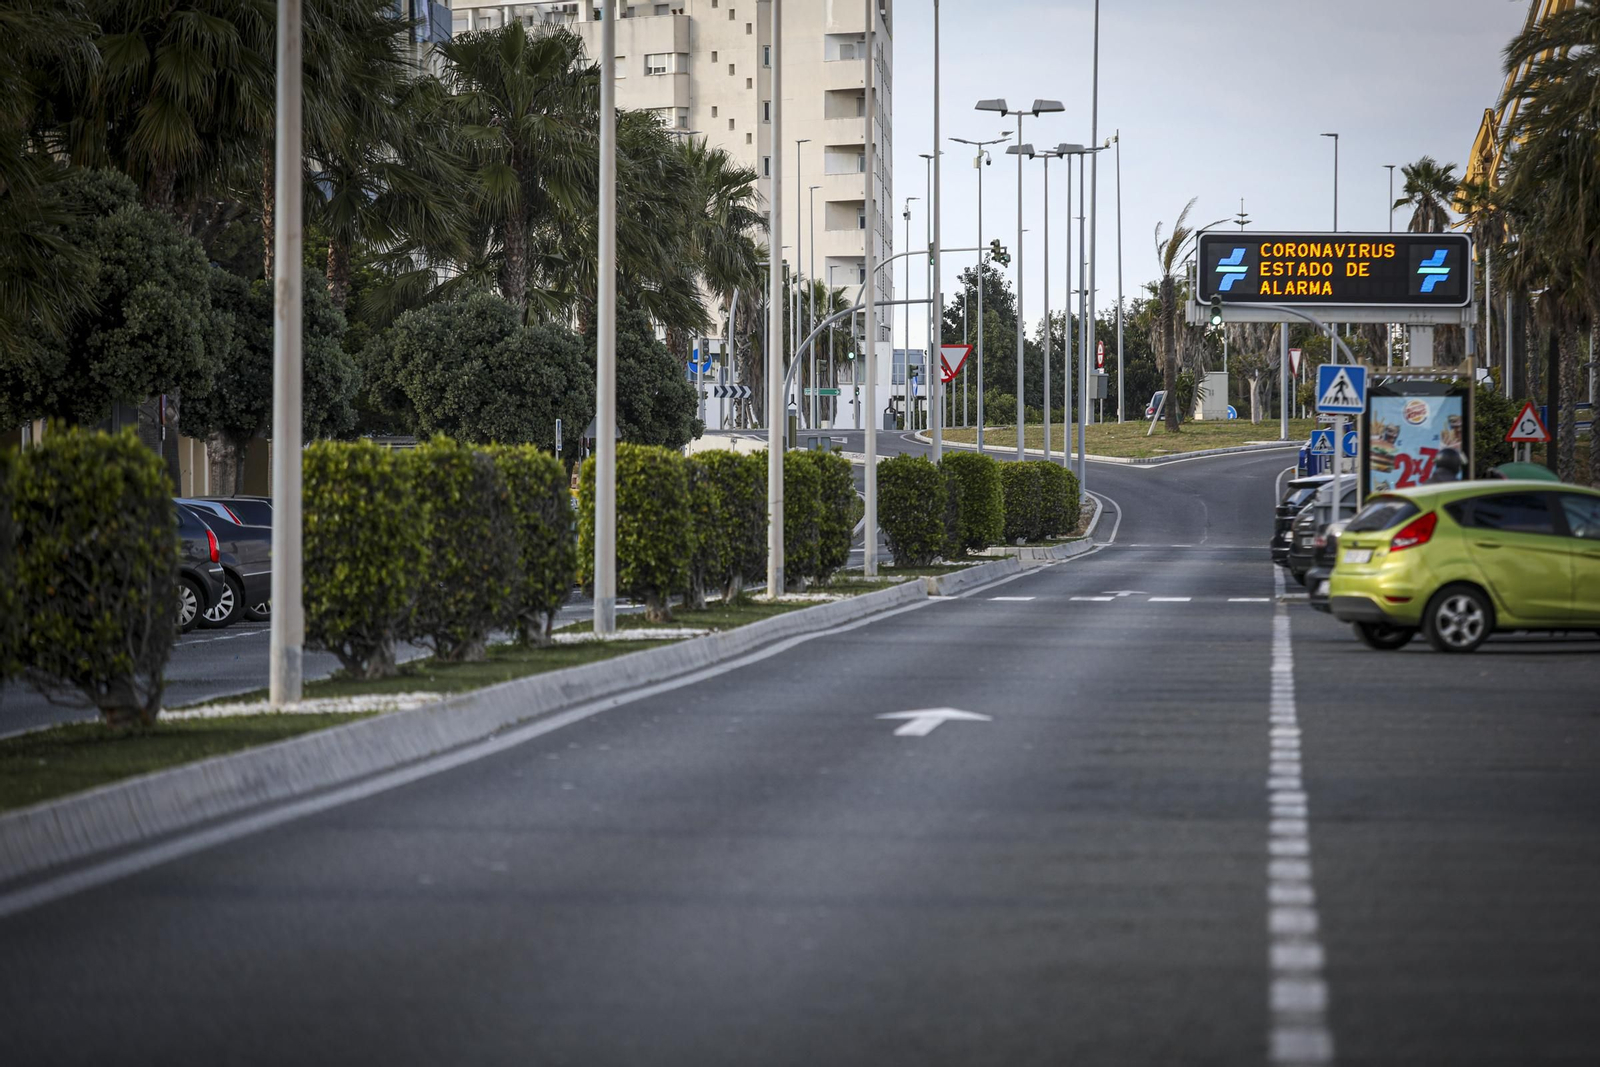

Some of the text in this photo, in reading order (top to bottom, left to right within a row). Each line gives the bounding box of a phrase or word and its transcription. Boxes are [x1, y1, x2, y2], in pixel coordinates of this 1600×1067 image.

[1259, 242, 1396, 258] CORONAVIRUS
[1259, 261, 1370, 277] ESTADO DE
[1259, 280, 1333, 296] ALARMA
